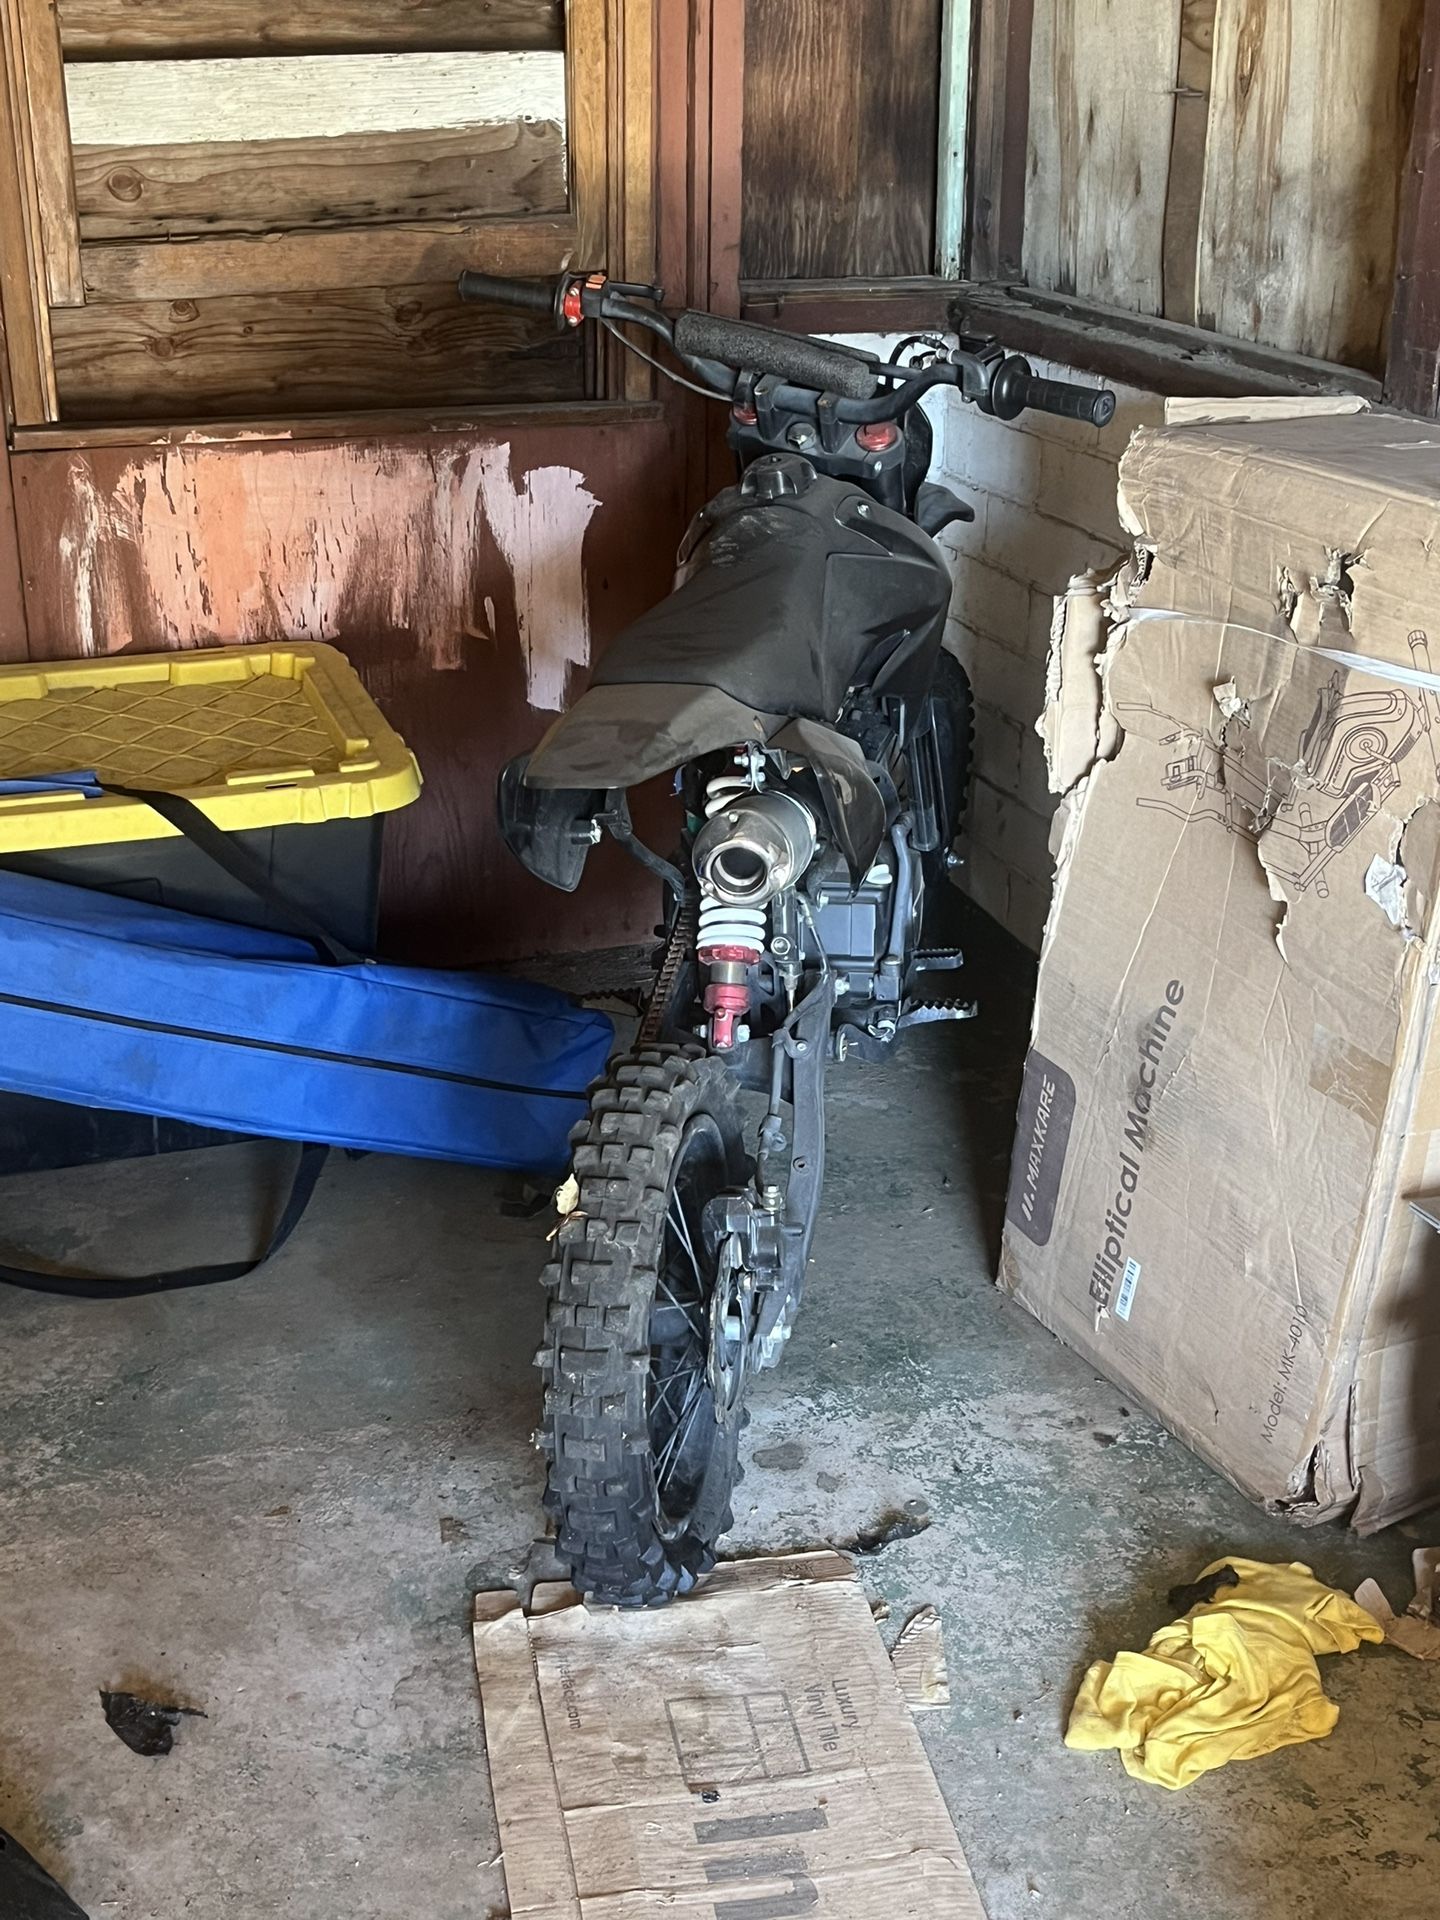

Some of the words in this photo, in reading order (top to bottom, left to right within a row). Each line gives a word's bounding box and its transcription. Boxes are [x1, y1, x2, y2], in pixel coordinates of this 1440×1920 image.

[1026, 1074, 1055, 1191] MAXKARE
[1089, 1151, 1141, 1308] Elliptical
[1124, 979, 1184, 1152] Machine
[1260, 1381, 1288, 1444] Model:
[1278, 1304, 1308, 1381] MK-4010
[556, 1652, 582, 1730] nterface.com
[804, 1683, 833, 1720] Vinyl
[832, 1679, 861, 1728] Luxury
[817, 1721, 840, 1752] Tile
